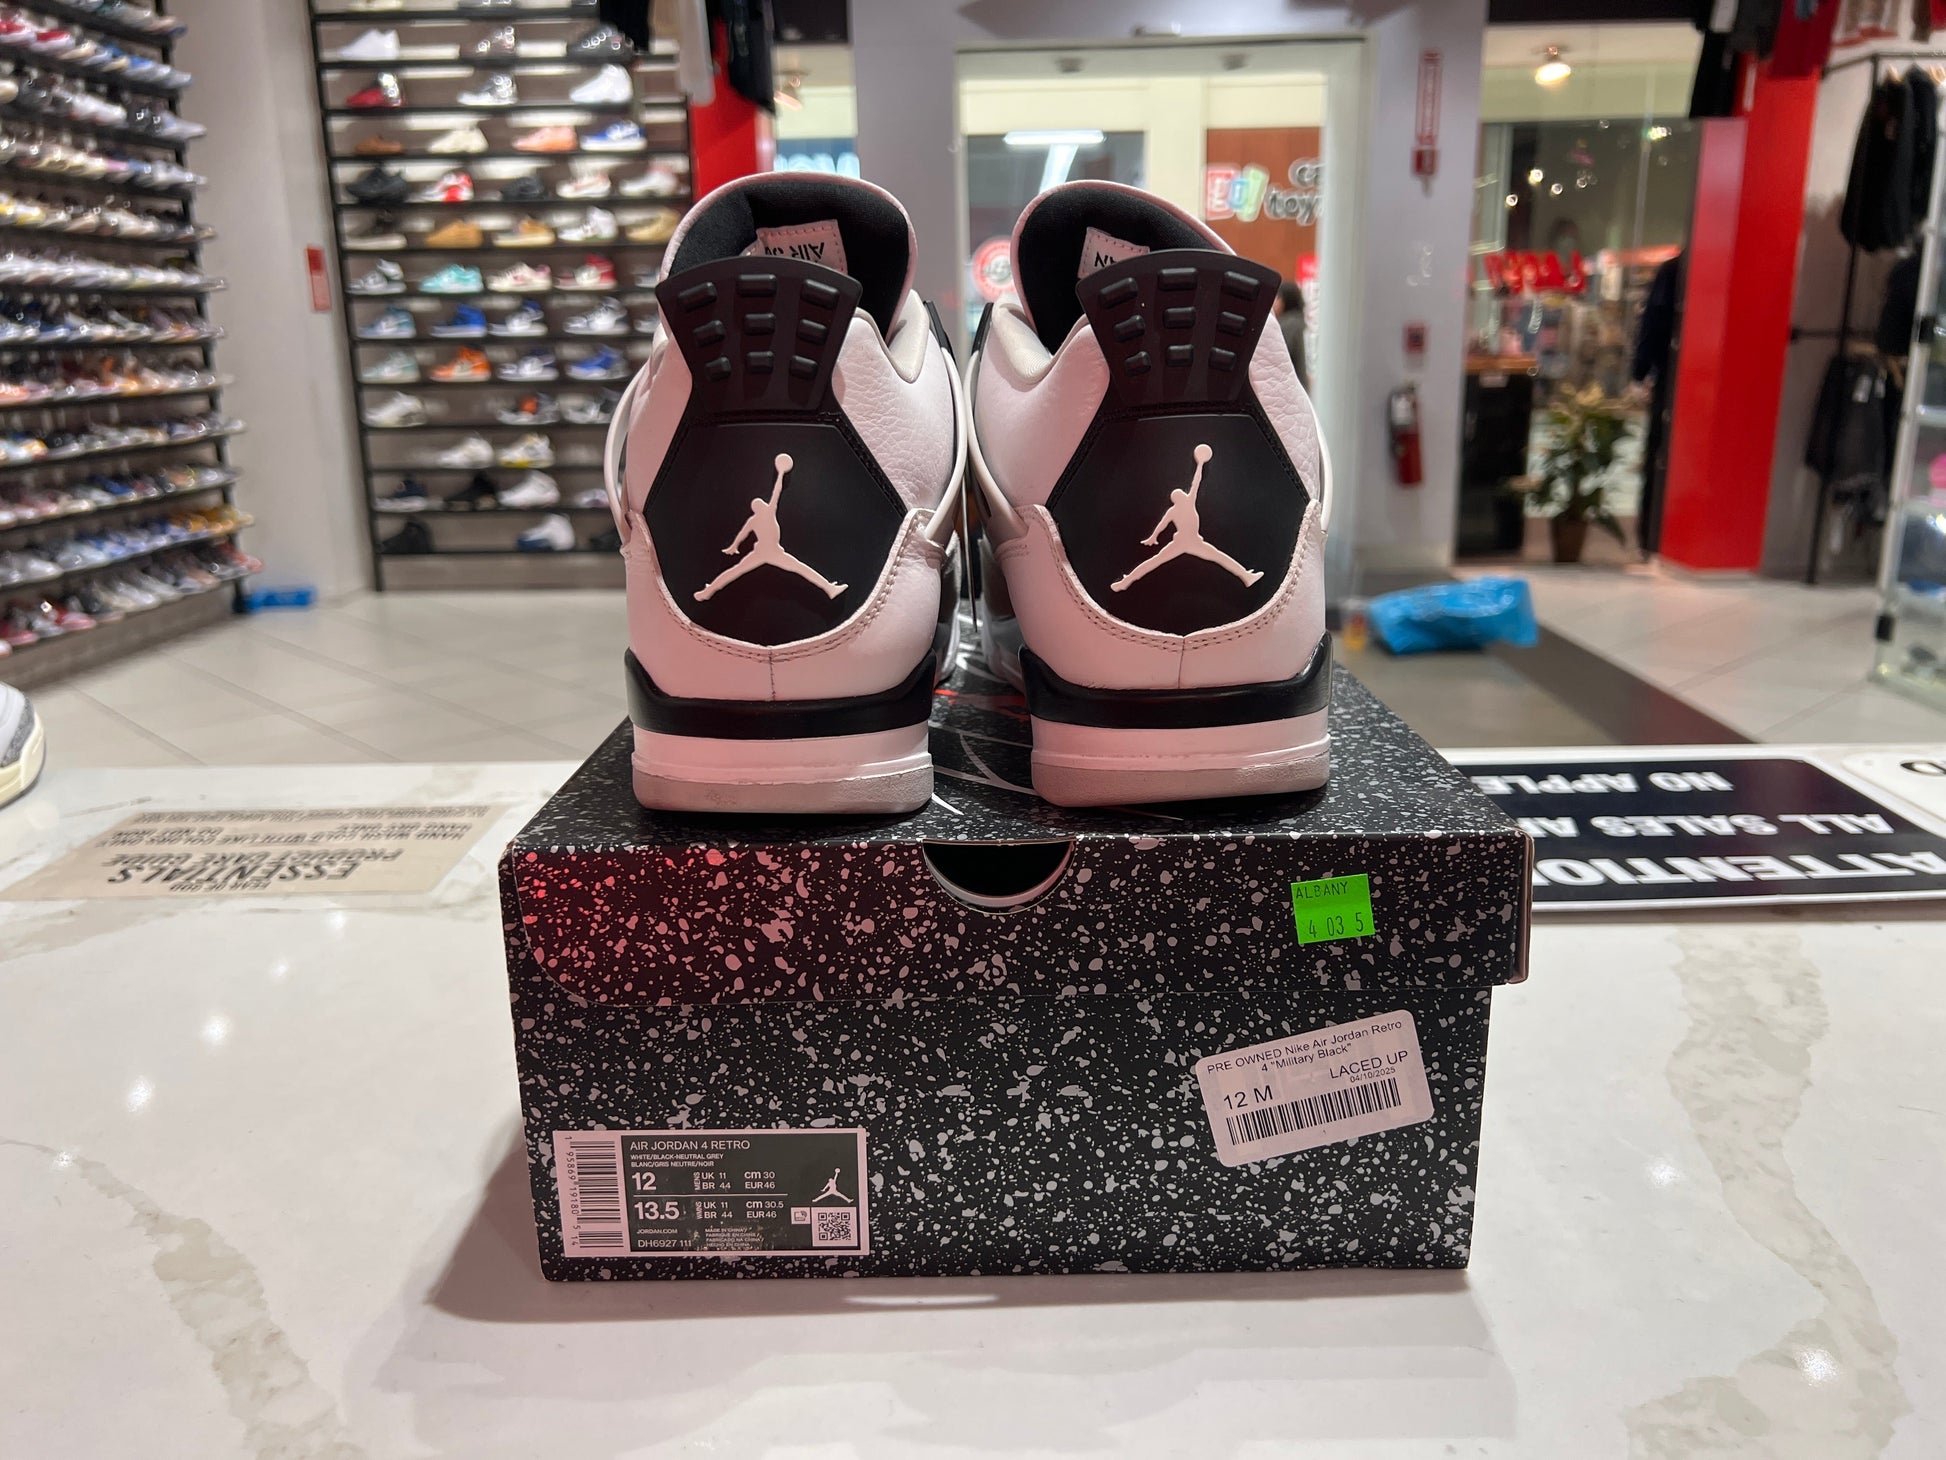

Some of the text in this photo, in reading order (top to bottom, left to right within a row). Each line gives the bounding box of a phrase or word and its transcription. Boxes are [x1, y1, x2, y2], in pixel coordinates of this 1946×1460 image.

[1470, 771, 1733, 796] NO APPLE
[1590, 814, 1778, 837] SALES
[1778, 813, 1894, 835] ALL
[101, 848, 404, 867] PRODUCT CARE GUIDE
[107, 862, 361, 884] ESSENTIALS
[169, 879, 271, 892] FEAR OF GOD
[1296, 881, 1348, 899] ALBANY
[1309, 919, 1317, 938] 4
[1355, 912, 1364, 932] 5
[1207, 1020, 1402, 1075] PRE OWNED Nike Air Jordan Retro
[1261, 1043, 1352, 1072] 4 "Military Black"
[1329, 1050, 1408, 1079] LACED UP
[1350, 1067, 1396, 1083] 04/10/2025
[1224, 1085, 1273, 1110] 12 M
[630, 1139, 751, 1151] AIR JORDAN 4 RETRO
[566, 1151, 577, 1181] 95869
[744, 1171, 761, 1179] cm
[763, 1171, 776, 1179] 30
[631, 1172, 657, 1191] 12
[702, 1182, 716, 1190] BR
[744, 1181, 764, 1189] EUR
[764, 1181, 776, 1189] 46
[569, 1187, 580, 1215] 19180
[634, 1201, 680, 1220] 13.5
[703, 1201, 717, 1209] UK
[745, 1201, 763, 1209] cm
[764, 1200, 784, 1209] 30.5
[704, 1211, 717, 1219] BR
[746, 1211, 766, 1219] EUR
[766, 1210, 777, 1218] 46
[637, 1239, 692, 1248] DH6927 111
